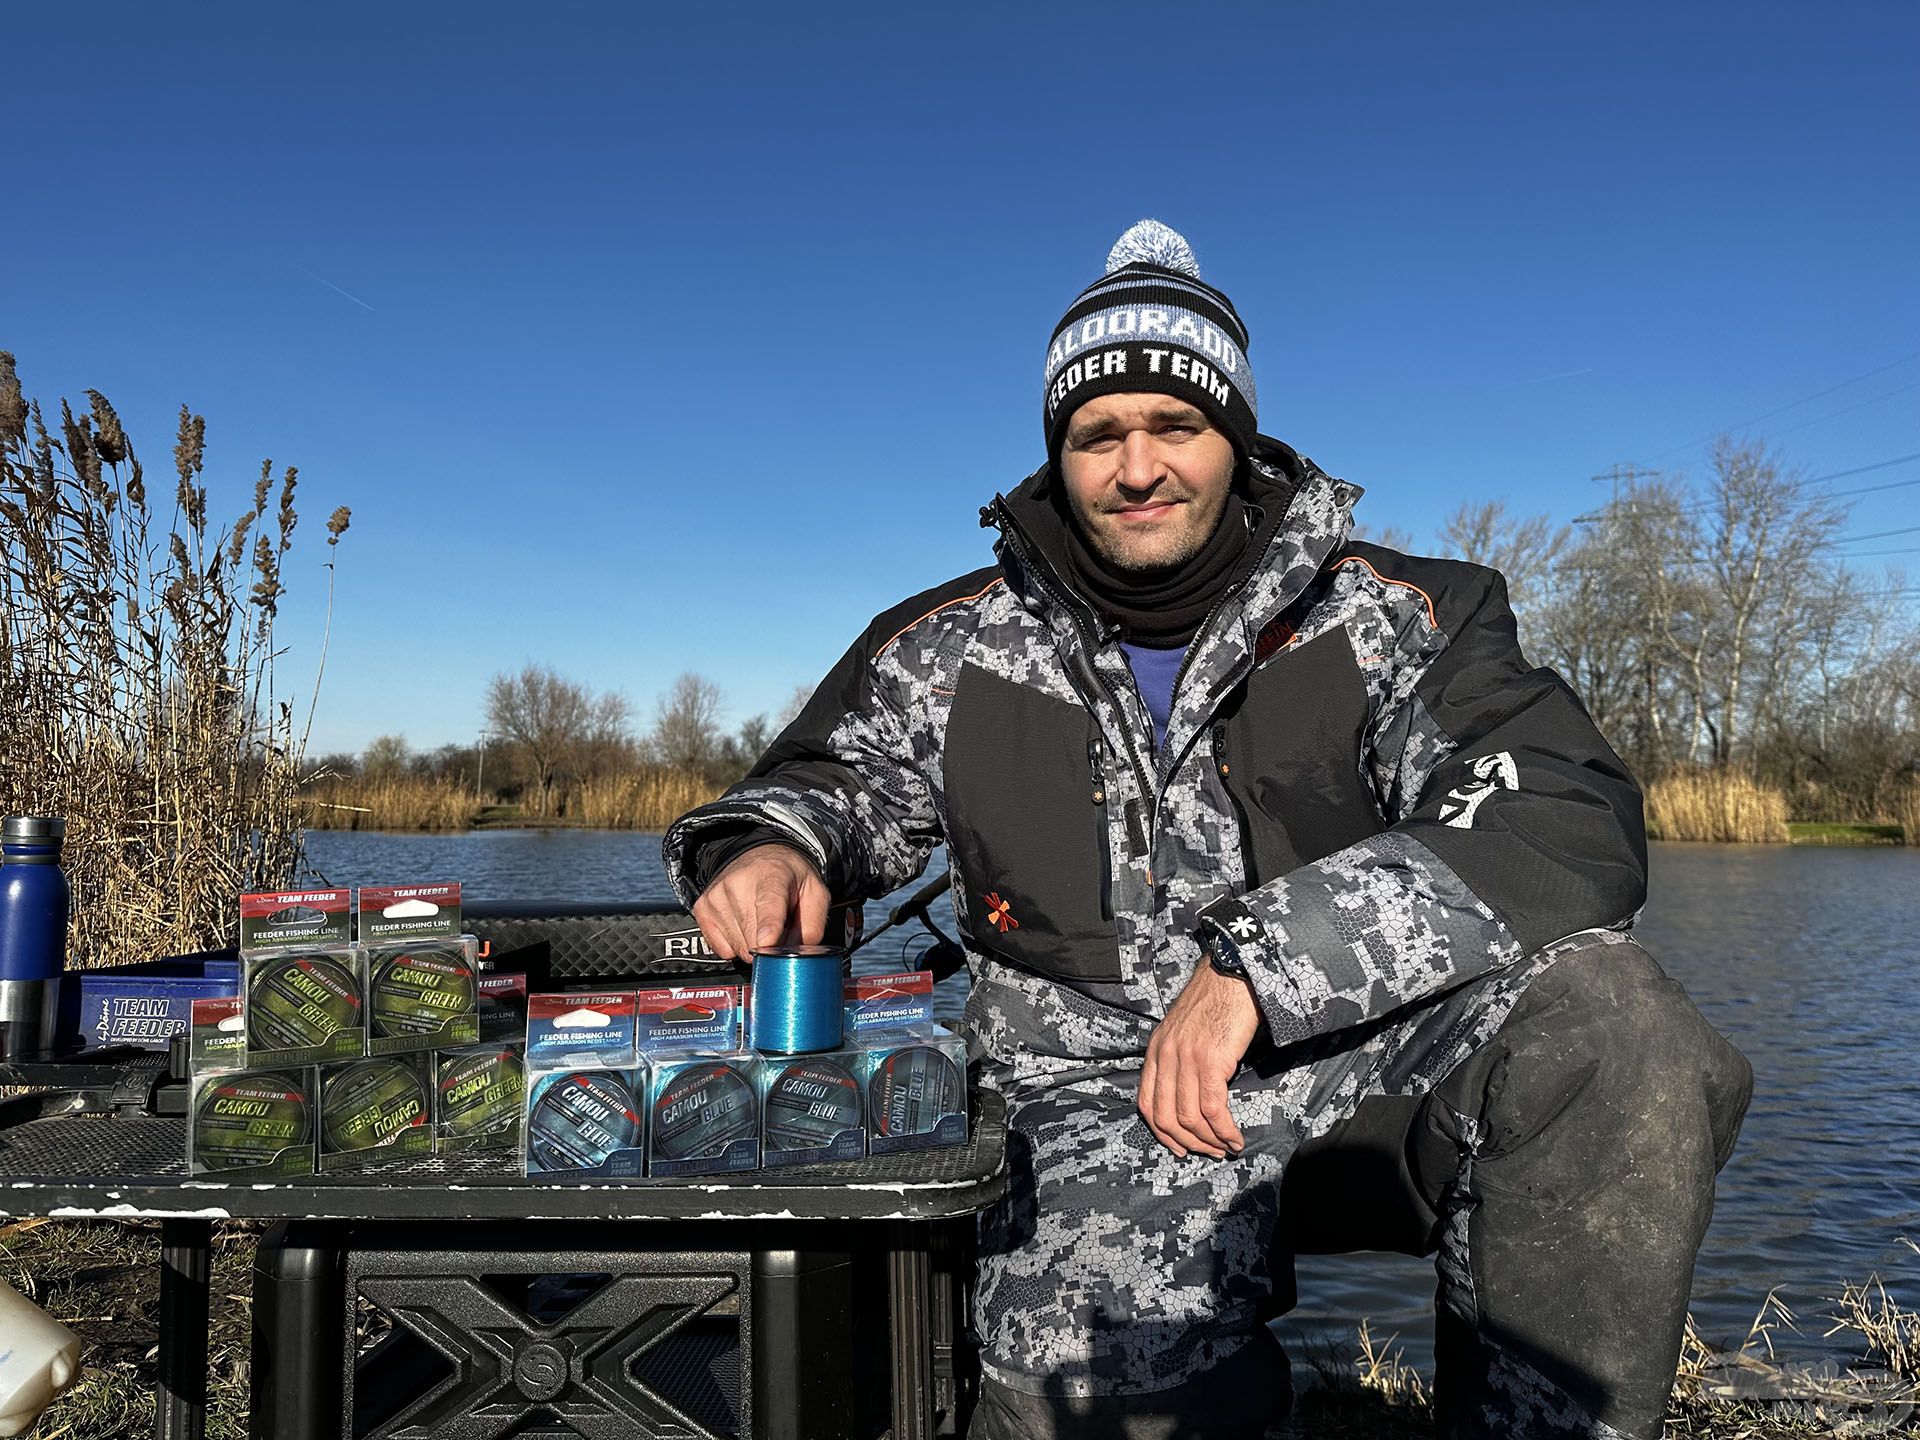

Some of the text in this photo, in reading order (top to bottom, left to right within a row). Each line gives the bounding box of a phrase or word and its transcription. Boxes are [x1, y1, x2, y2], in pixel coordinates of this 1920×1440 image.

[1047, 309, 1237, 380] ALDORADO
[1142, 349, 1230, 407] TEAM
[278, 895, 302, 903] TEAM
[304, 894, 336, 902] FEEDER
[394, 889, 417, 897] TEAM
[254, 930, 285, 939] FEEDER
[286, 928, 319, 937] FISHING
[665, 937, 714, 956] RIV
[283, 968, 332, 1004] CAMOU
[391, 967, 442, 988] CAMOU
[484, 979, 513, 987] FEEDER
[873, 978, 894, 986] TEAM
[895, 976, 921, 984] FEEDER
[420, 990, 462, 1009] GREEN
[591, 996, 622, 1004] FEEDER
[696, 990, 724, 998] FEEDER
[114, 998, 170, 1017] TEAM
[856, 1012, 879, 1020] EEDER
[880, 1010, 908, 1018] FISHING
[111, 1018, 186, 1038] FEEDER
[300, 1004, 340, 1034] GREEN
[570, 1032, 603, 1040] FISHING
[649, 1028, 677, 1036] FEEDER
[205, 1038, 237, 1046] FEEDER
[455, 1058, 498, 1082] TEAM FEEDER
[446, 1071, 491, 1105] CAMOU
[486, 1076, 523, 1103] GREEN
[671, 1074, 714, 1100] TEAM FEEDER
[782, 1078, 828, 1099] CAMOU
[910, 1066, 925, 1098] BLUE
[258, 1091, 286, 1100] FEEDER
[562, 1085, 610, 1122] CAMOU
[214, 1099, 271, 1117] CAMOU
[663, 1089, 708, 1125] CAMOU
[703, 1096, 733, 1122] BLUE
[808, 1102, 842, 1120] BLUE
[891, 1085, 908, 1132] CAMOU
[250, 1120, 295, 1137] GREEN
[341, 1105, 380, 1140] GREEN
[374, 1100, 419, 1138] CAMOU
